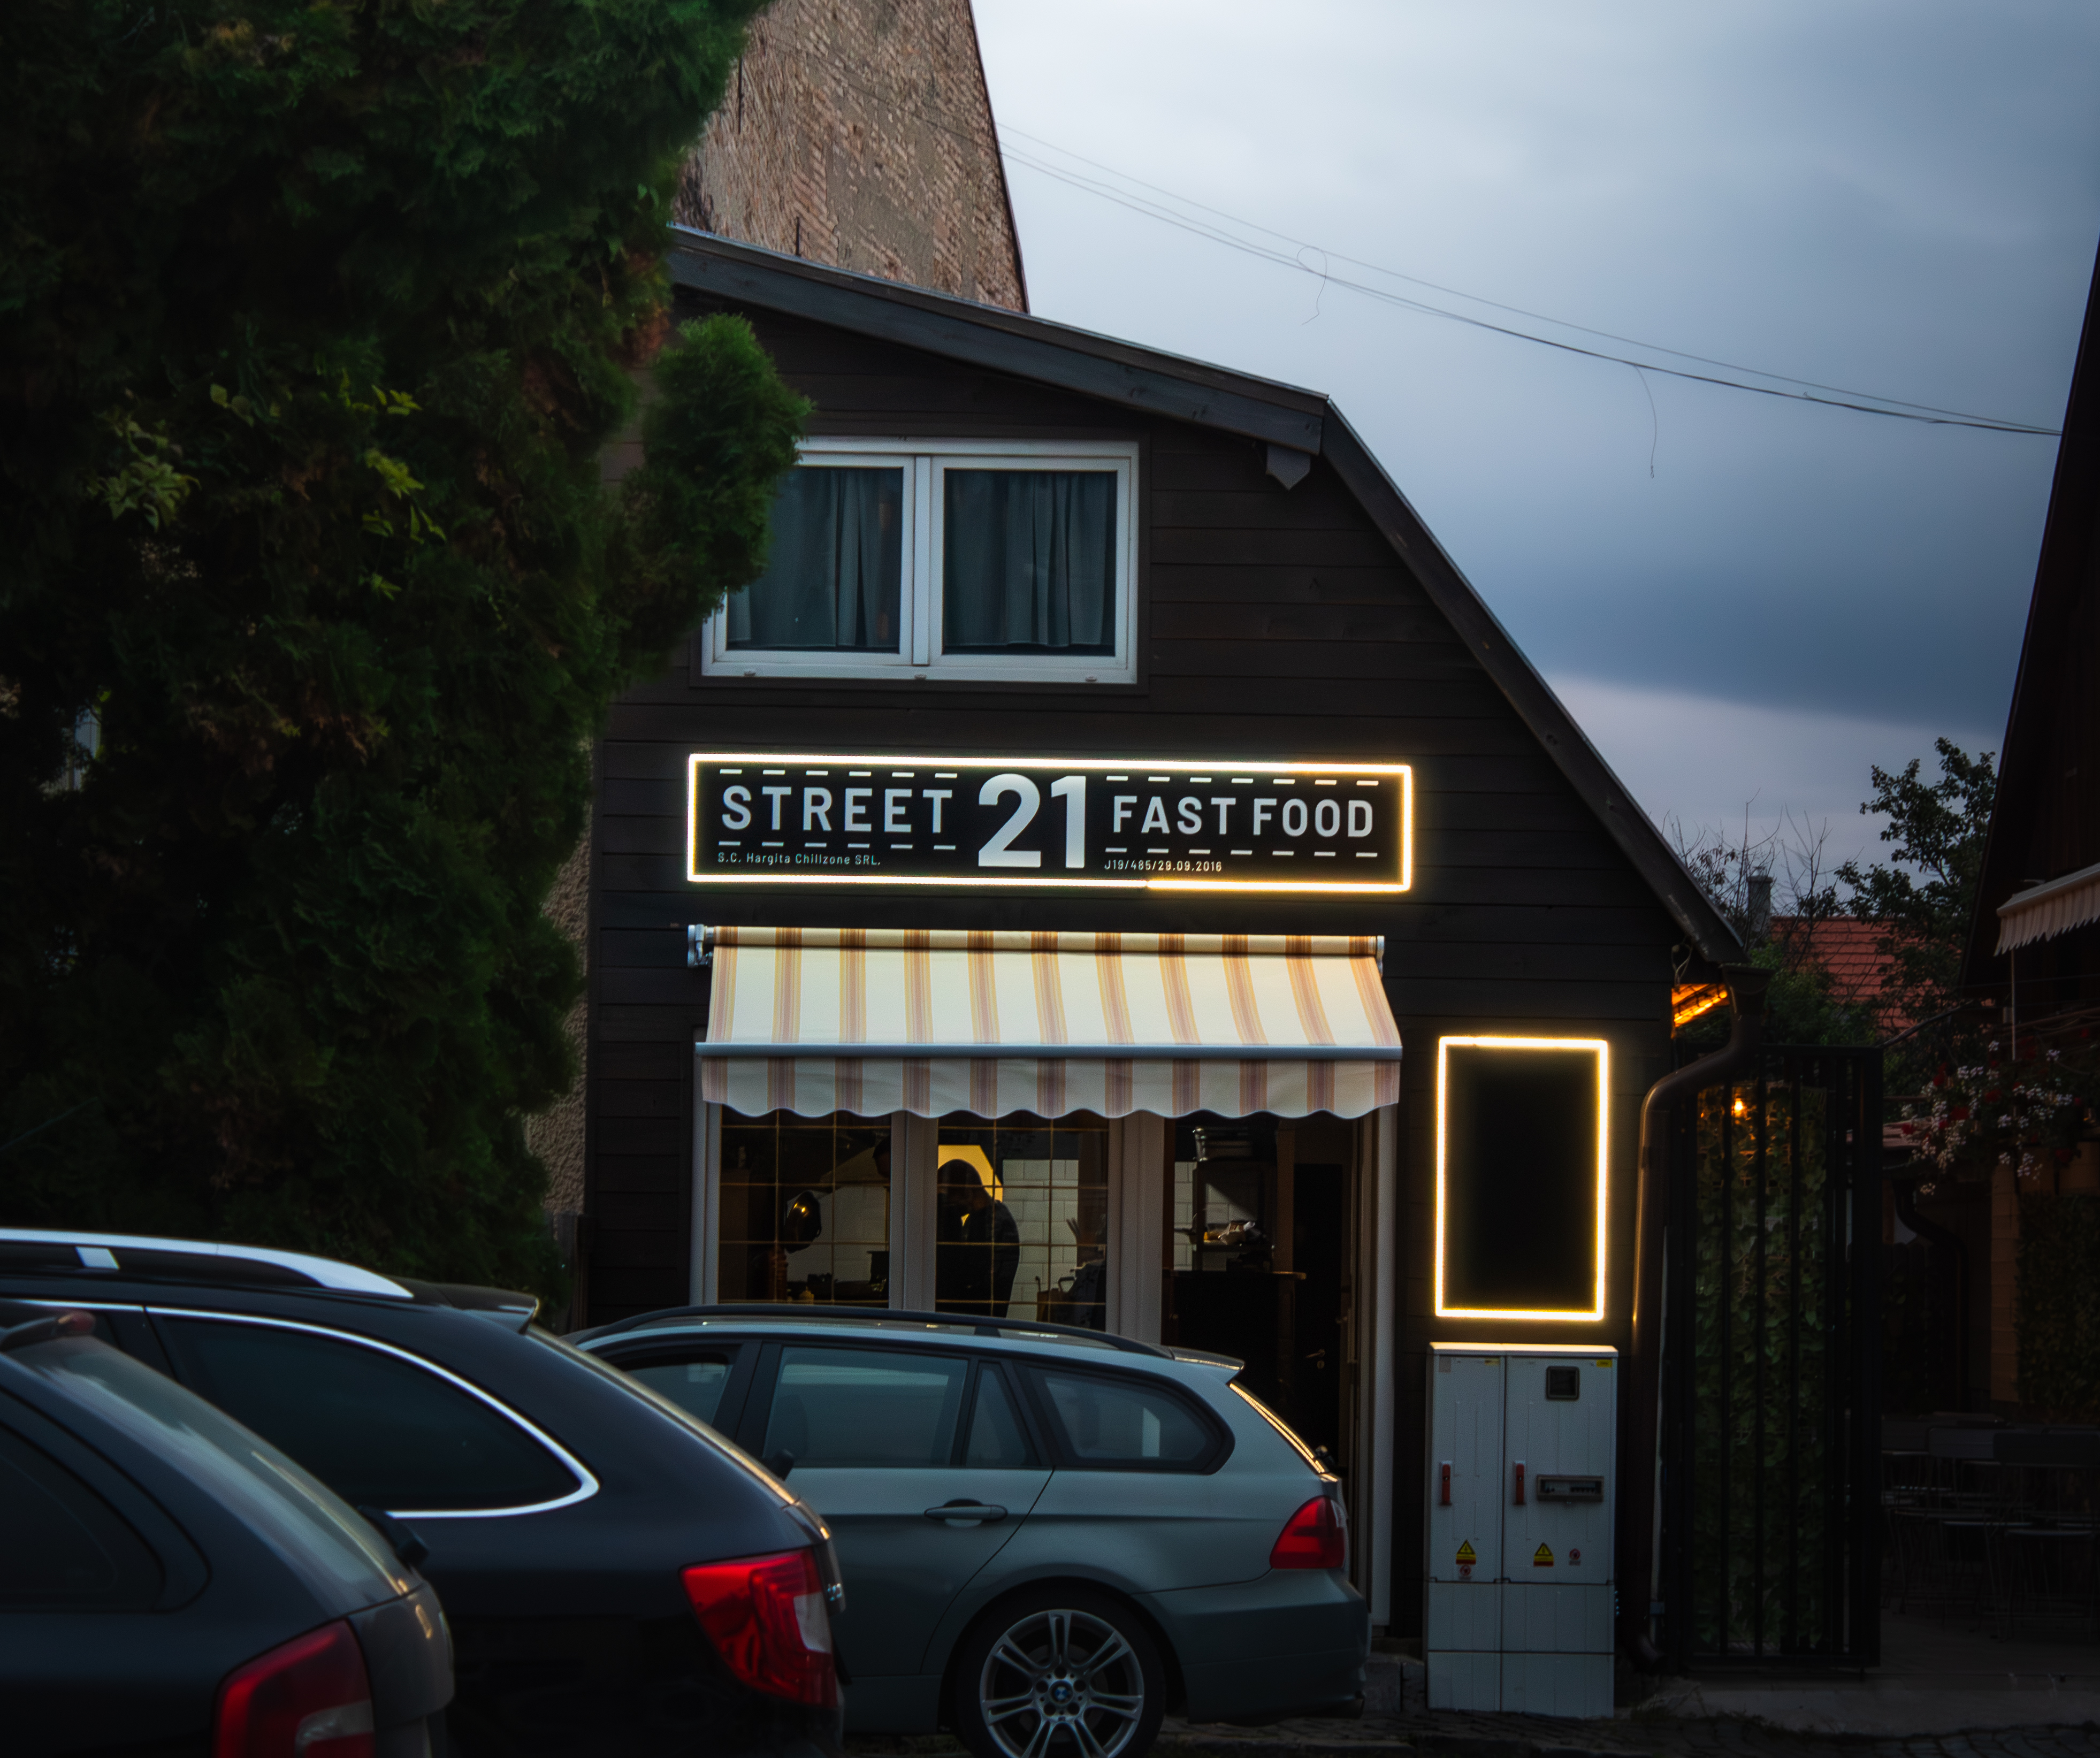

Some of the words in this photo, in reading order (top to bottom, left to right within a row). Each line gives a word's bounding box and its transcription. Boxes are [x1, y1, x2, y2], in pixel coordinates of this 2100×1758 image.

[722, 785, 953, 834] STREET
[978, 773, 1087, 869] 21
[1113, 794, 1236, 836] FAST
[1253, 797, 1373, 838] FOOD
[717, 852, 741, 863] S.C.
[746, 852, 791, 866] Hargita
[795, 853, 850, 866] Chillzone
[855, 854, 881, 866] SRL.
